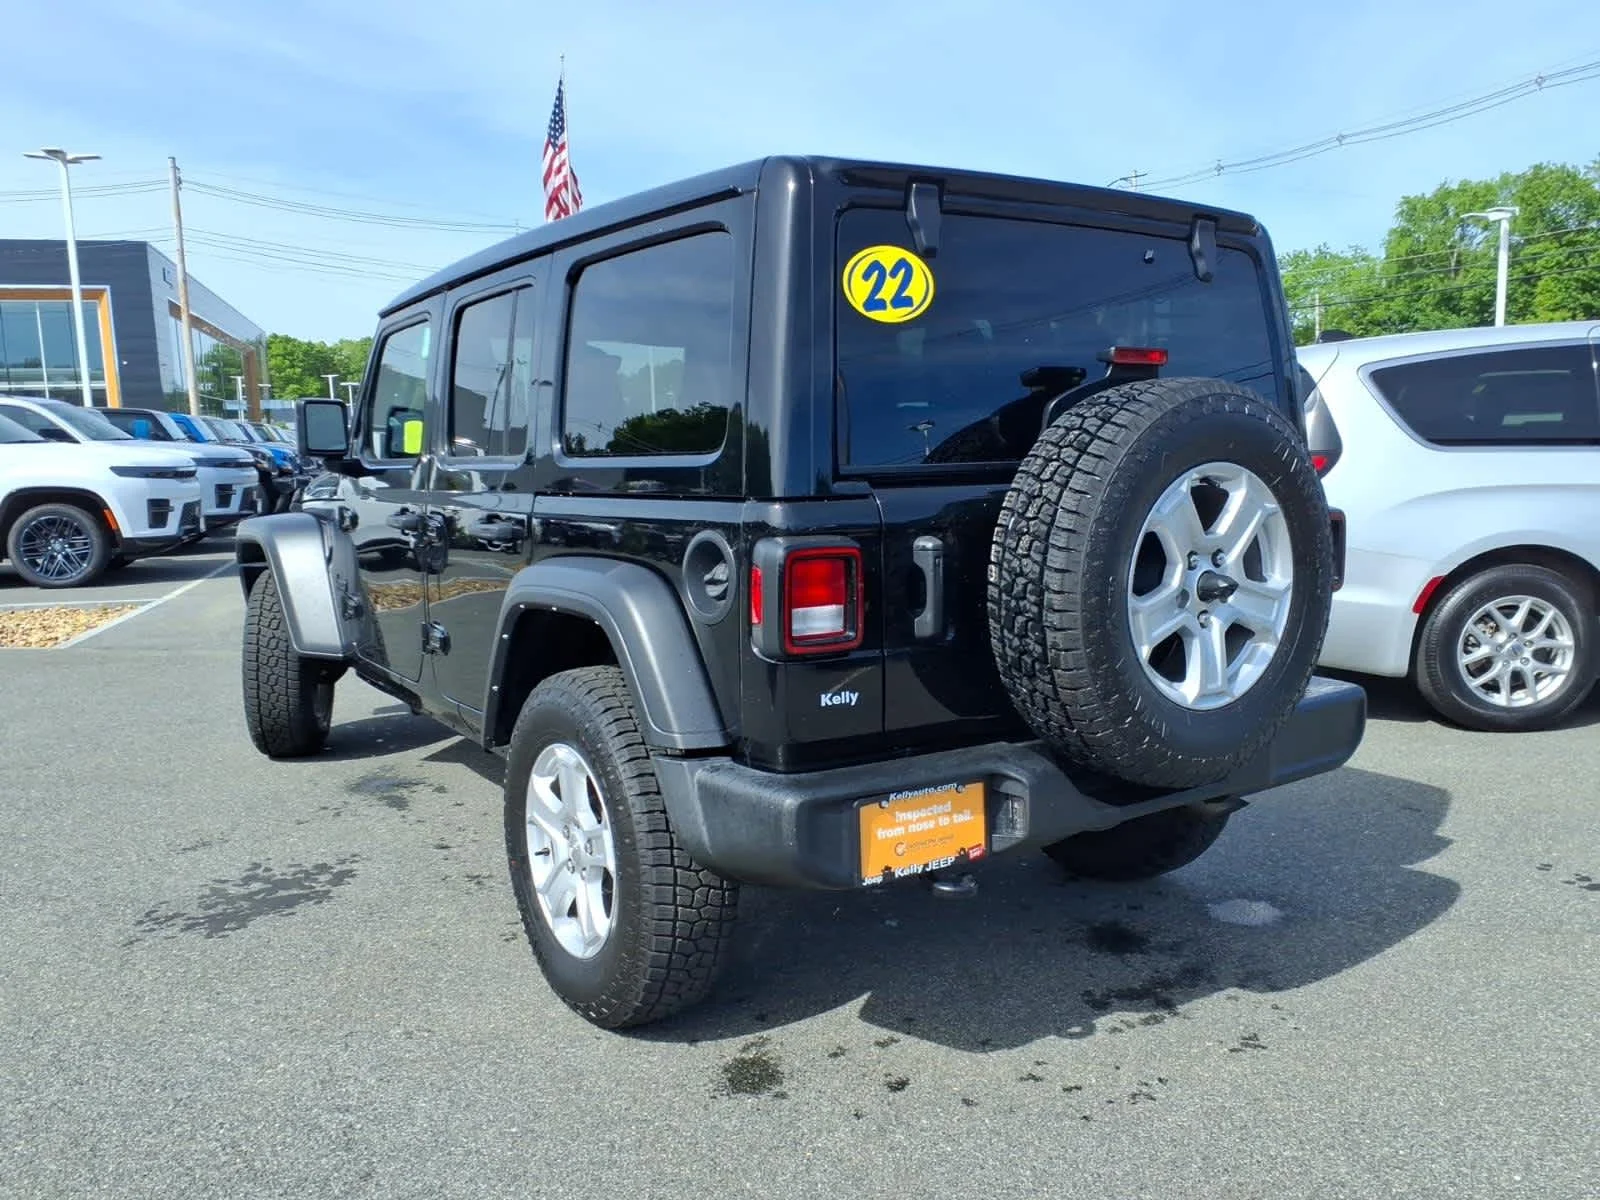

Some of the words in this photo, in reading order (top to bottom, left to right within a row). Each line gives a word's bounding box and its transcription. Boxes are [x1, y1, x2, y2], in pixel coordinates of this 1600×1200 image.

[862, 258, 914, 312] 22
[820, 691, 859, 707] Kelly
[877, 826, 904, 840] from
[908, 819, 935, 832] nose
[938, 816, 950, 826] to
[894, 864, 924, 878] Kelly
[925, 856, 955, 872] JEEP
